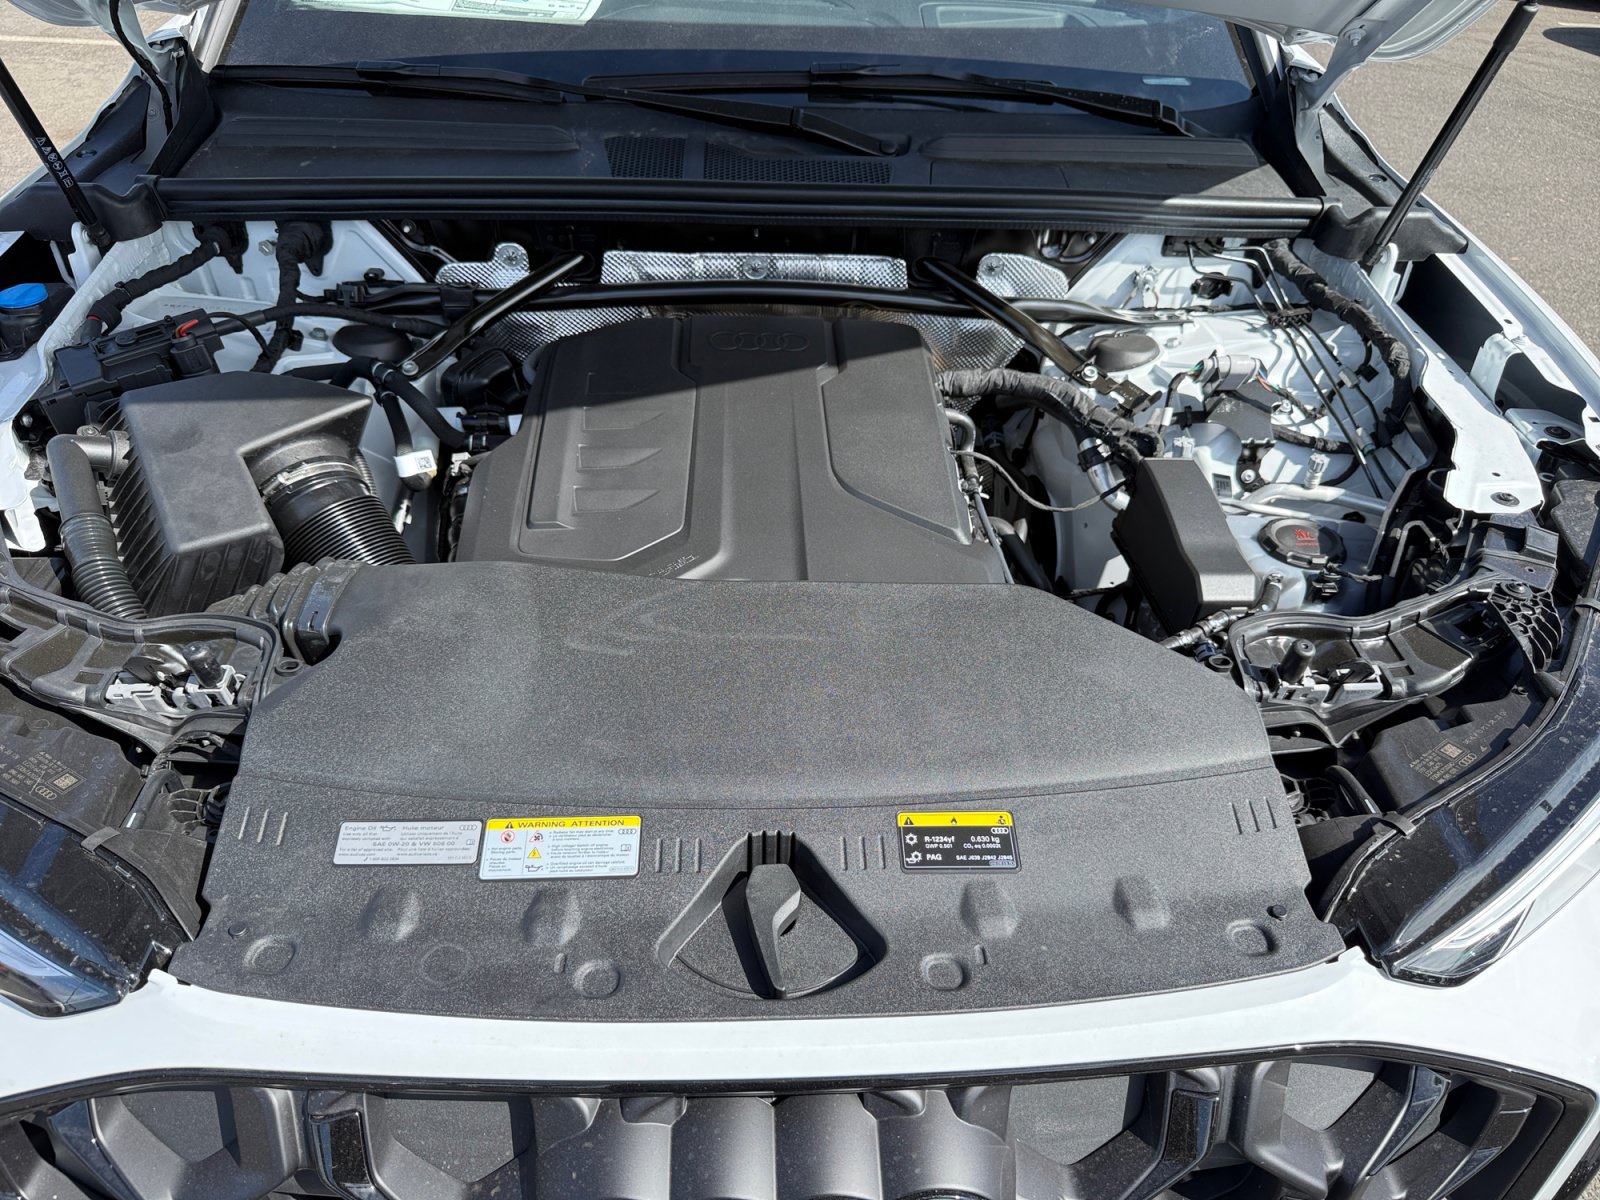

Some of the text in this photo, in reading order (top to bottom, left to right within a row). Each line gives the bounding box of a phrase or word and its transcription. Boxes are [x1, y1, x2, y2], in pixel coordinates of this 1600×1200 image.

[518, 819, 625, 828] WARNING ATTENTION
[924, 835, 955, 844] R-1234yf
[990, 835, 1001, 844] kg
[926, 853, 942, 861] PAG
